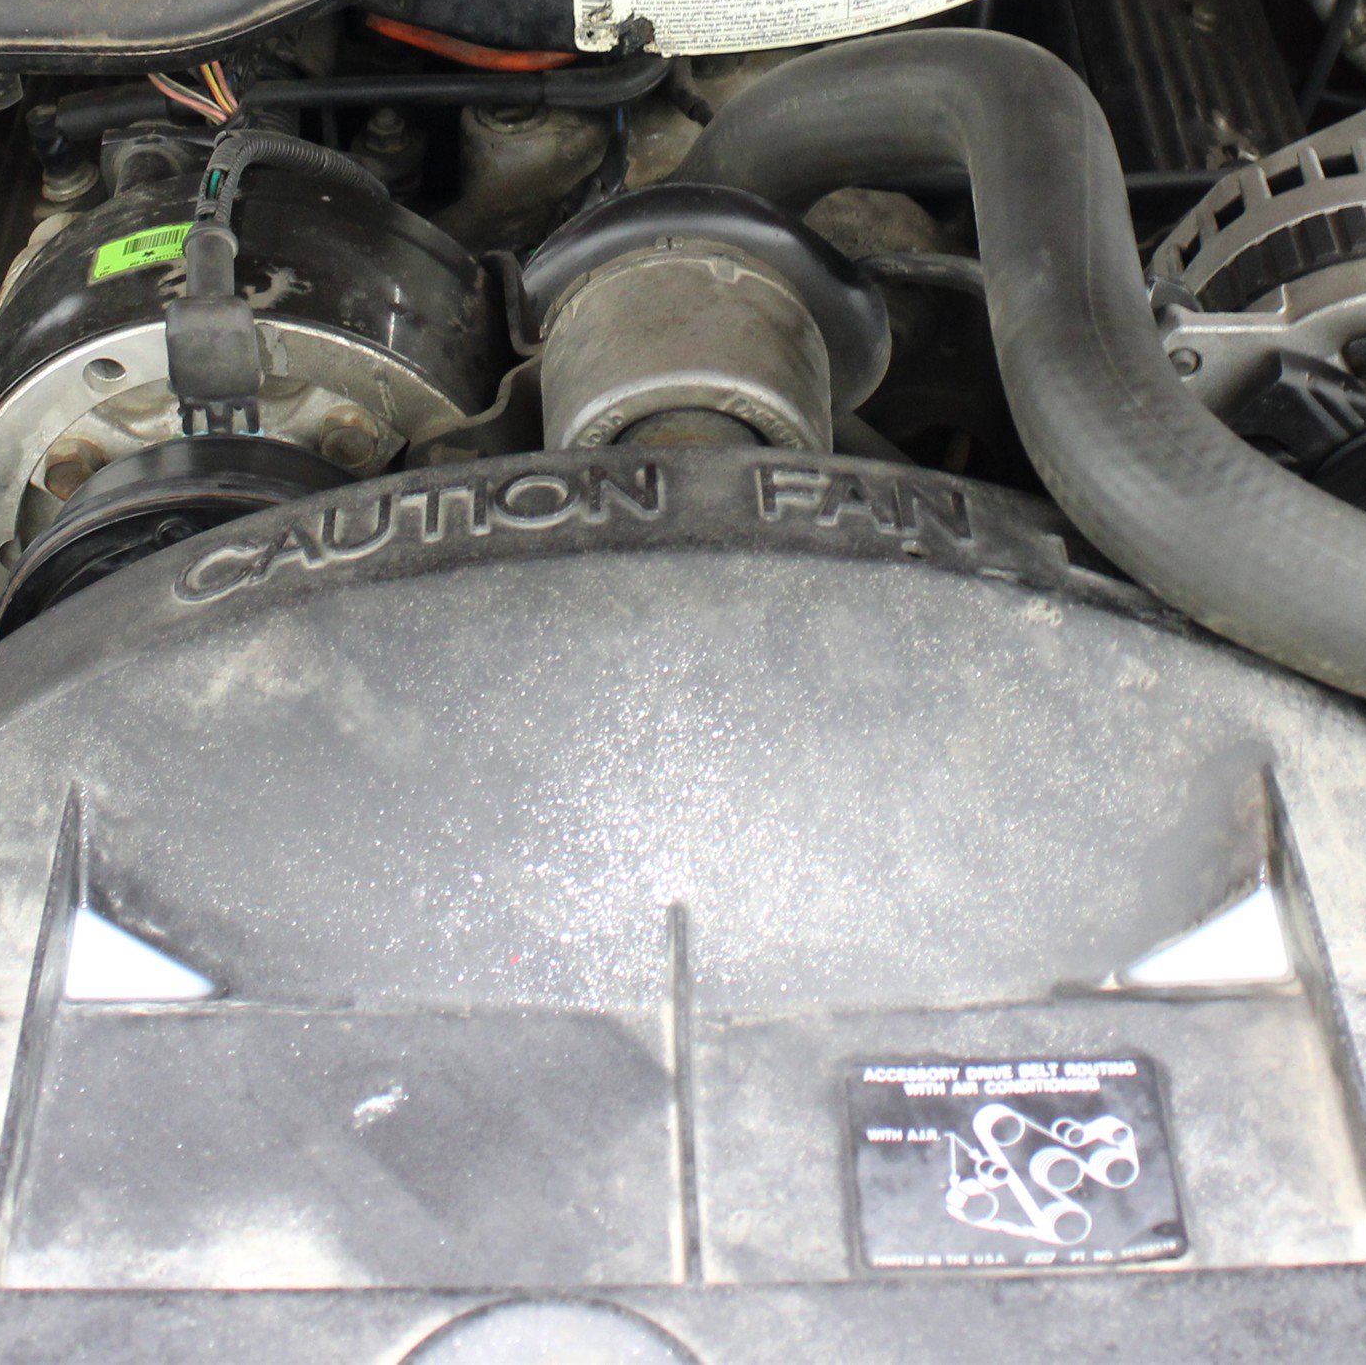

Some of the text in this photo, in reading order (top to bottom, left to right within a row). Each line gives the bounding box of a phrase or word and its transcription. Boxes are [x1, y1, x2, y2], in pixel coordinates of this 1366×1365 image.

[171, 461, 977, 605] CAUTION FAN
[862, 1059, 1138, 1083] ACCESSORY DRIVE BELT ROUTING
[903, 1076, 1101, 1096] WITH AIR CONDITIONING
[865, 1127, 904, 1142] WITH
